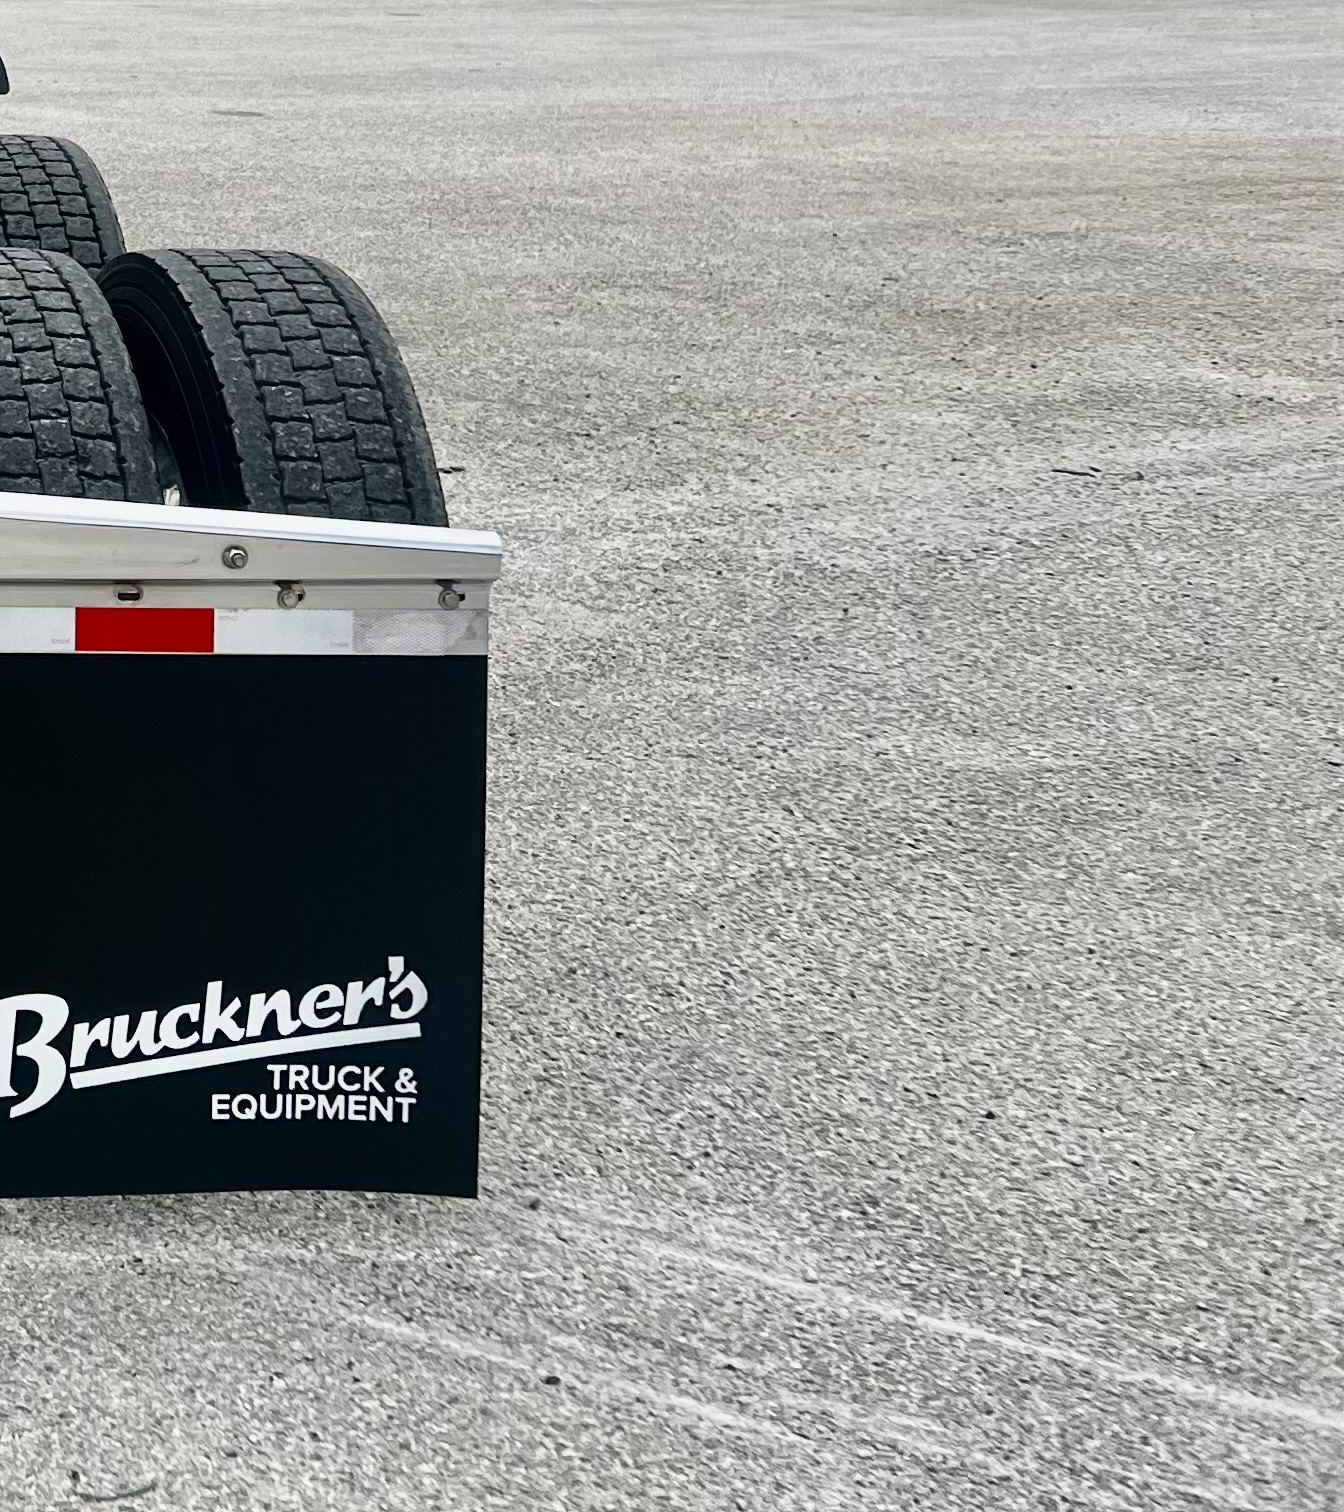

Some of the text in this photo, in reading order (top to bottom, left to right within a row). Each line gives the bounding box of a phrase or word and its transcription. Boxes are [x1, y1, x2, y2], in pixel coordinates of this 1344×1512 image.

[266, 1063, 419, 1094] TRUCK &
[211, 1093, 418, 1123] EQUIPMENT
